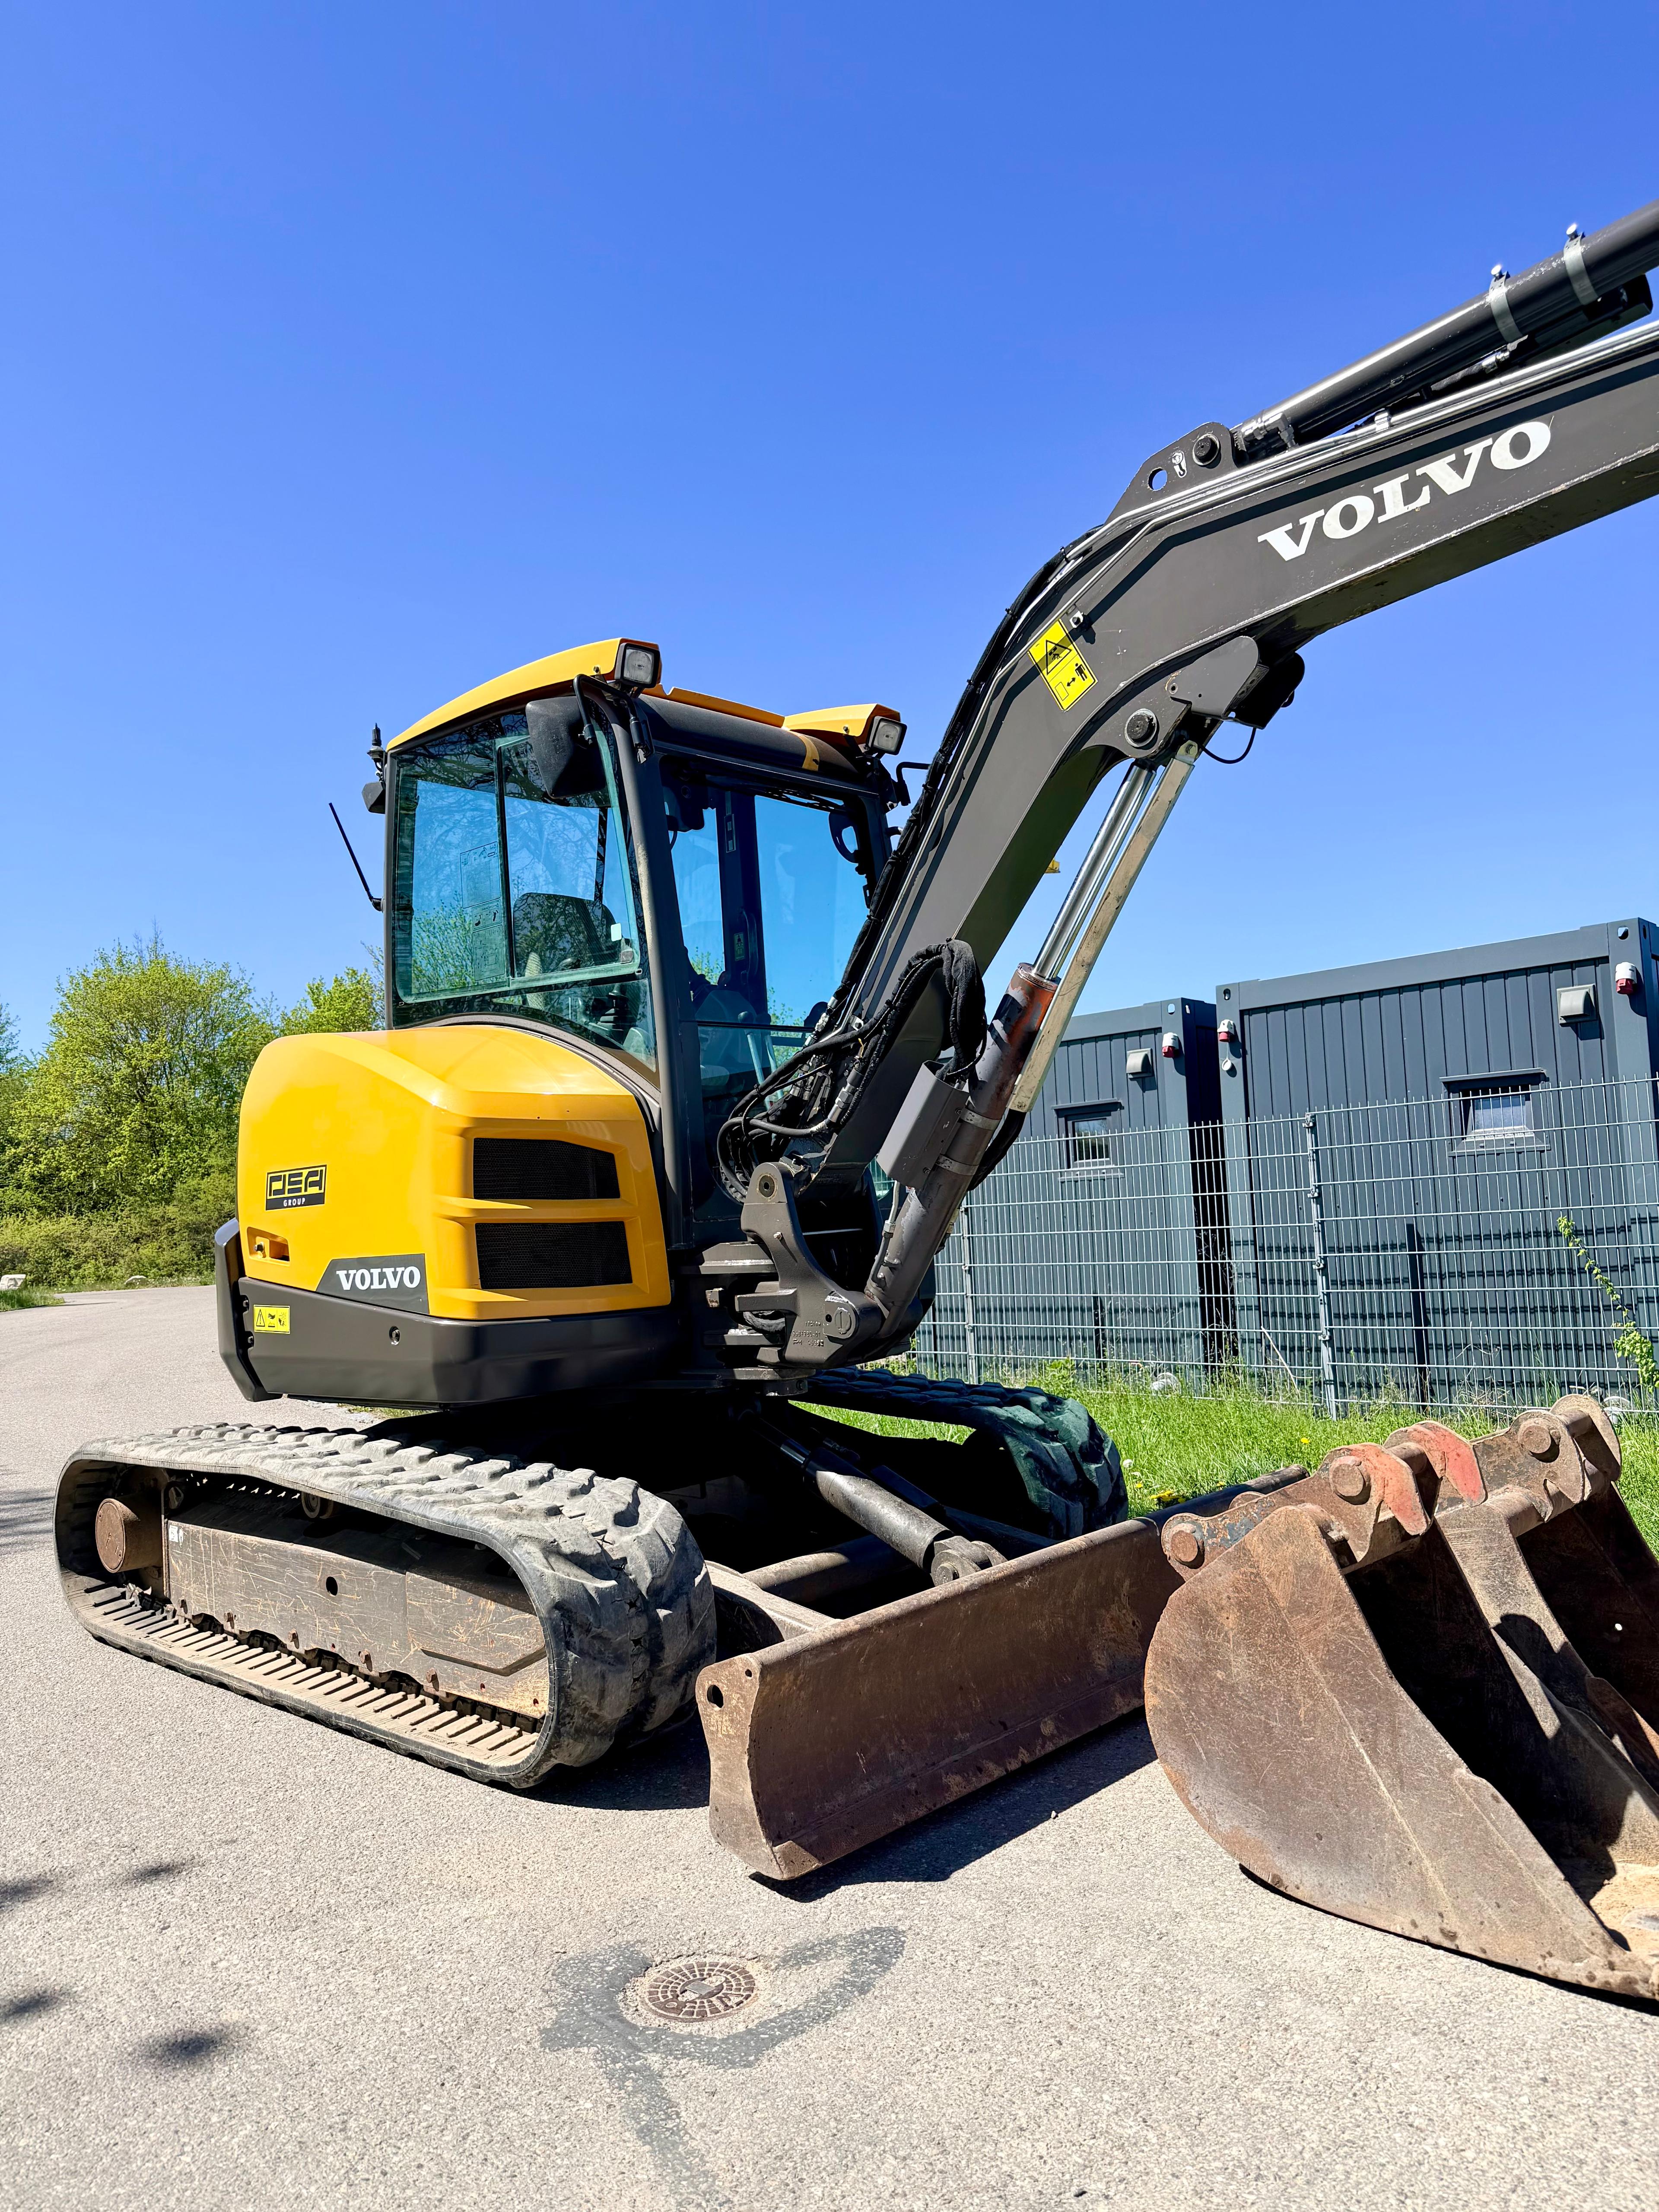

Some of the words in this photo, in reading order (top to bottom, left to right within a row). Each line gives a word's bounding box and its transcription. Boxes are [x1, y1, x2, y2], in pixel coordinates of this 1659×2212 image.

[1258, 421, 1551, 561] VOLVO
[283, 1198, 305, 1207] GROUP
[336, 1266, 421, 1290] VOLVO
